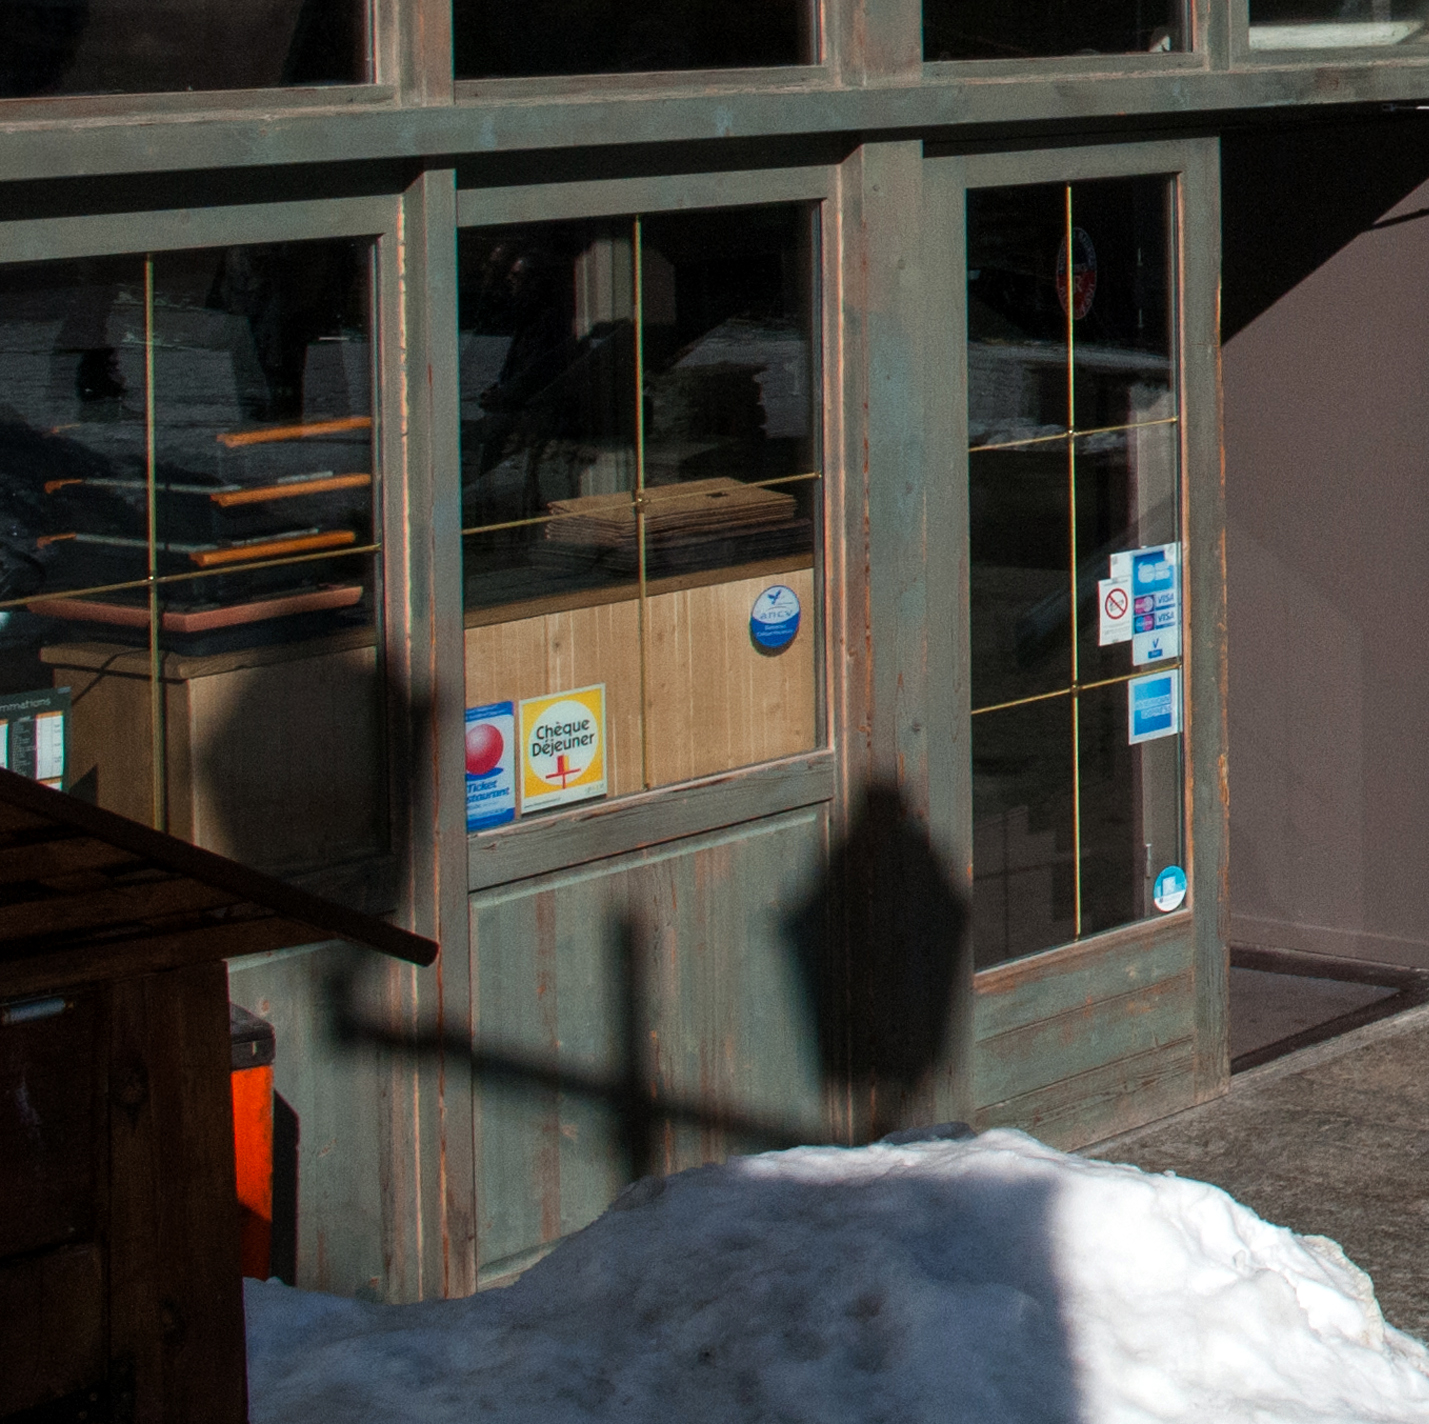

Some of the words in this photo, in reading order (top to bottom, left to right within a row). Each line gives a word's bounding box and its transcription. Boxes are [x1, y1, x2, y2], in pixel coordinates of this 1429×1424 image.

[1158, 593, 1174, 604] VISA
[1158, 611, 1174, 623] VISA
[536, 719, 590, 740] Chèque
[532, 733, 595, 757] Déjeuner
[467, 780, 498, 794] Ticket
